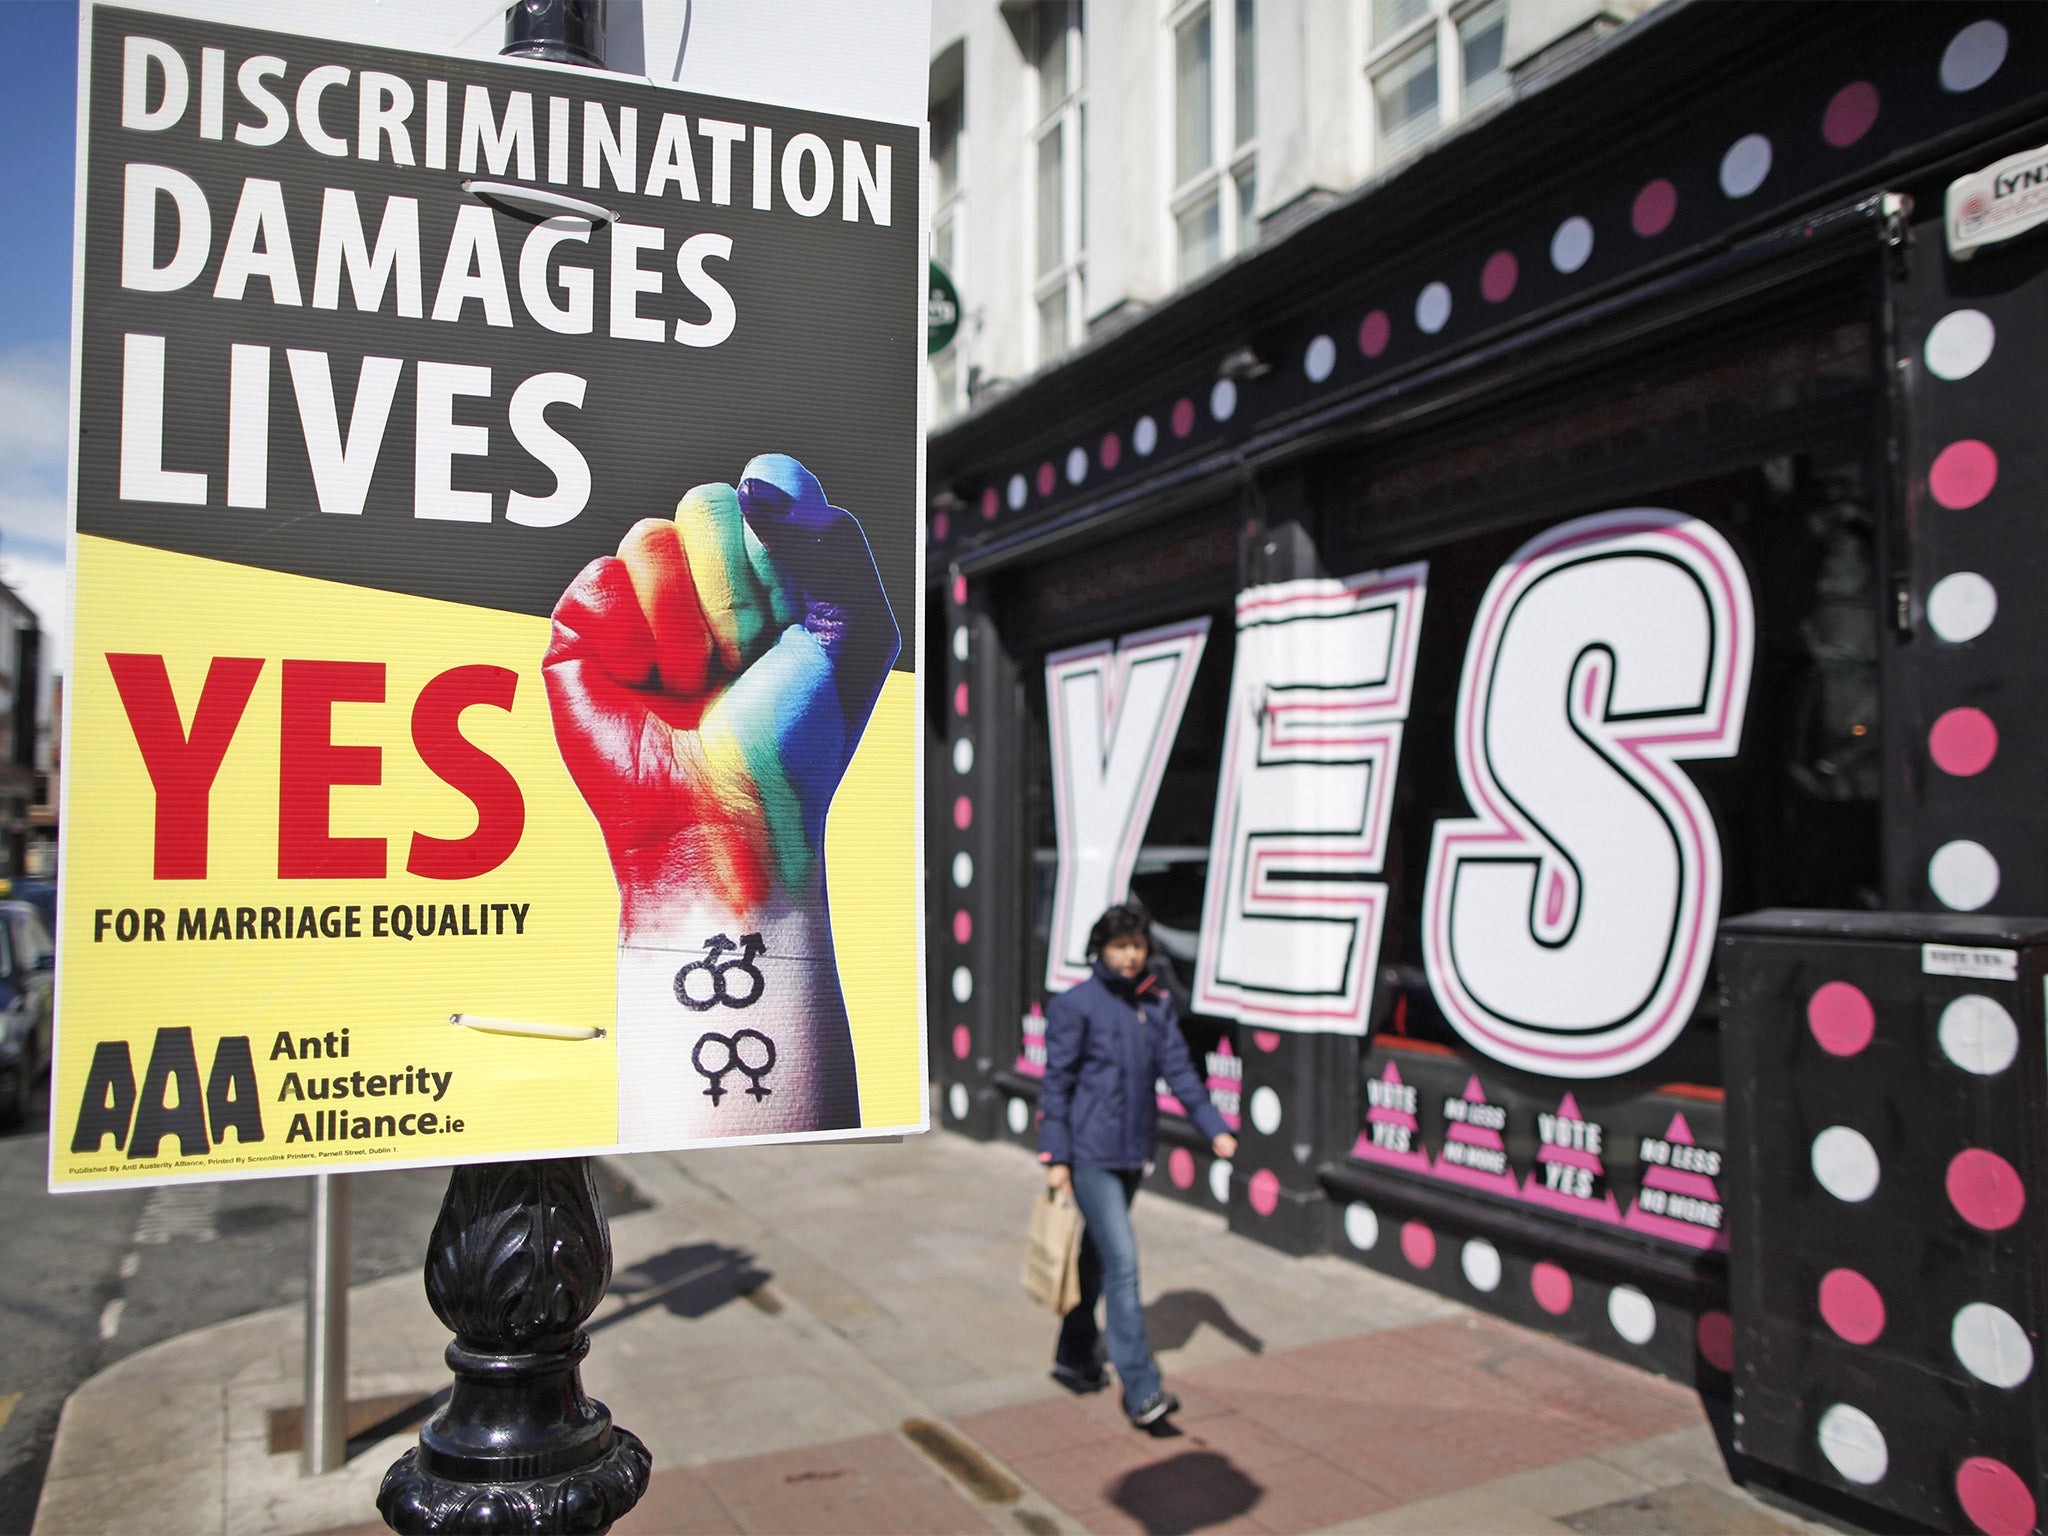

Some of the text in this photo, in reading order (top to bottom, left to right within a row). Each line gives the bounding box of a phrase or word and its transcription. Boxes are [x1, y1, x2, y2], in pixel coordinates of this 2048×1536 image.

[121, 35, 892, 227] DISCRIMINATION
[1994, 161, 2048, 199] LYN
[121, 163, 737, 347] DAMAGES
[119, 332, 593, 528] LIVES
[104, 652, 526, 881] YES
[1045, 507, 1755, 1079] YES
[94, 903, 530, 942] FOR MARRIAGE EQUALITY
[269, 1028, 350, 1060] Anti
[71, 1026, 265, 1159] AAA
[277, 1065, 453, 1102] Austerity
[1367, 1077, 1418, 1115] VOTE
[285, 1109, 465, 1144] Alliance.ie
[1372, 1121, 1412, 1153] YES
[1538, 1112, 1602, 1155] VOTE
[69, 1165, 107, 1174] Published
[110, 1164, 119, 1173] By
[122, 1163, 137, 1171] Anti
[139, 1161, 173, 1170] Austerity
[174, 1159, 206, 1168] Alliance,
[208, 1157, 235, 1165] Printed
[236, 1156, 245, 1164] By
[247, 1153, 285, 1163] Screenlink
[287, 1152, 317, 1160] Printers,
[318, 1150, 343, 1158] Parnell
[345, 1148, 367, 1156] Street,
[368, 1147, 391, 1155] Dublin
[1640, 1137, 1722, 1177] NO LESS
[1545, 1160, 1595, 1200] YES
[1639, 1186, 1724, 1229] NO MORE
